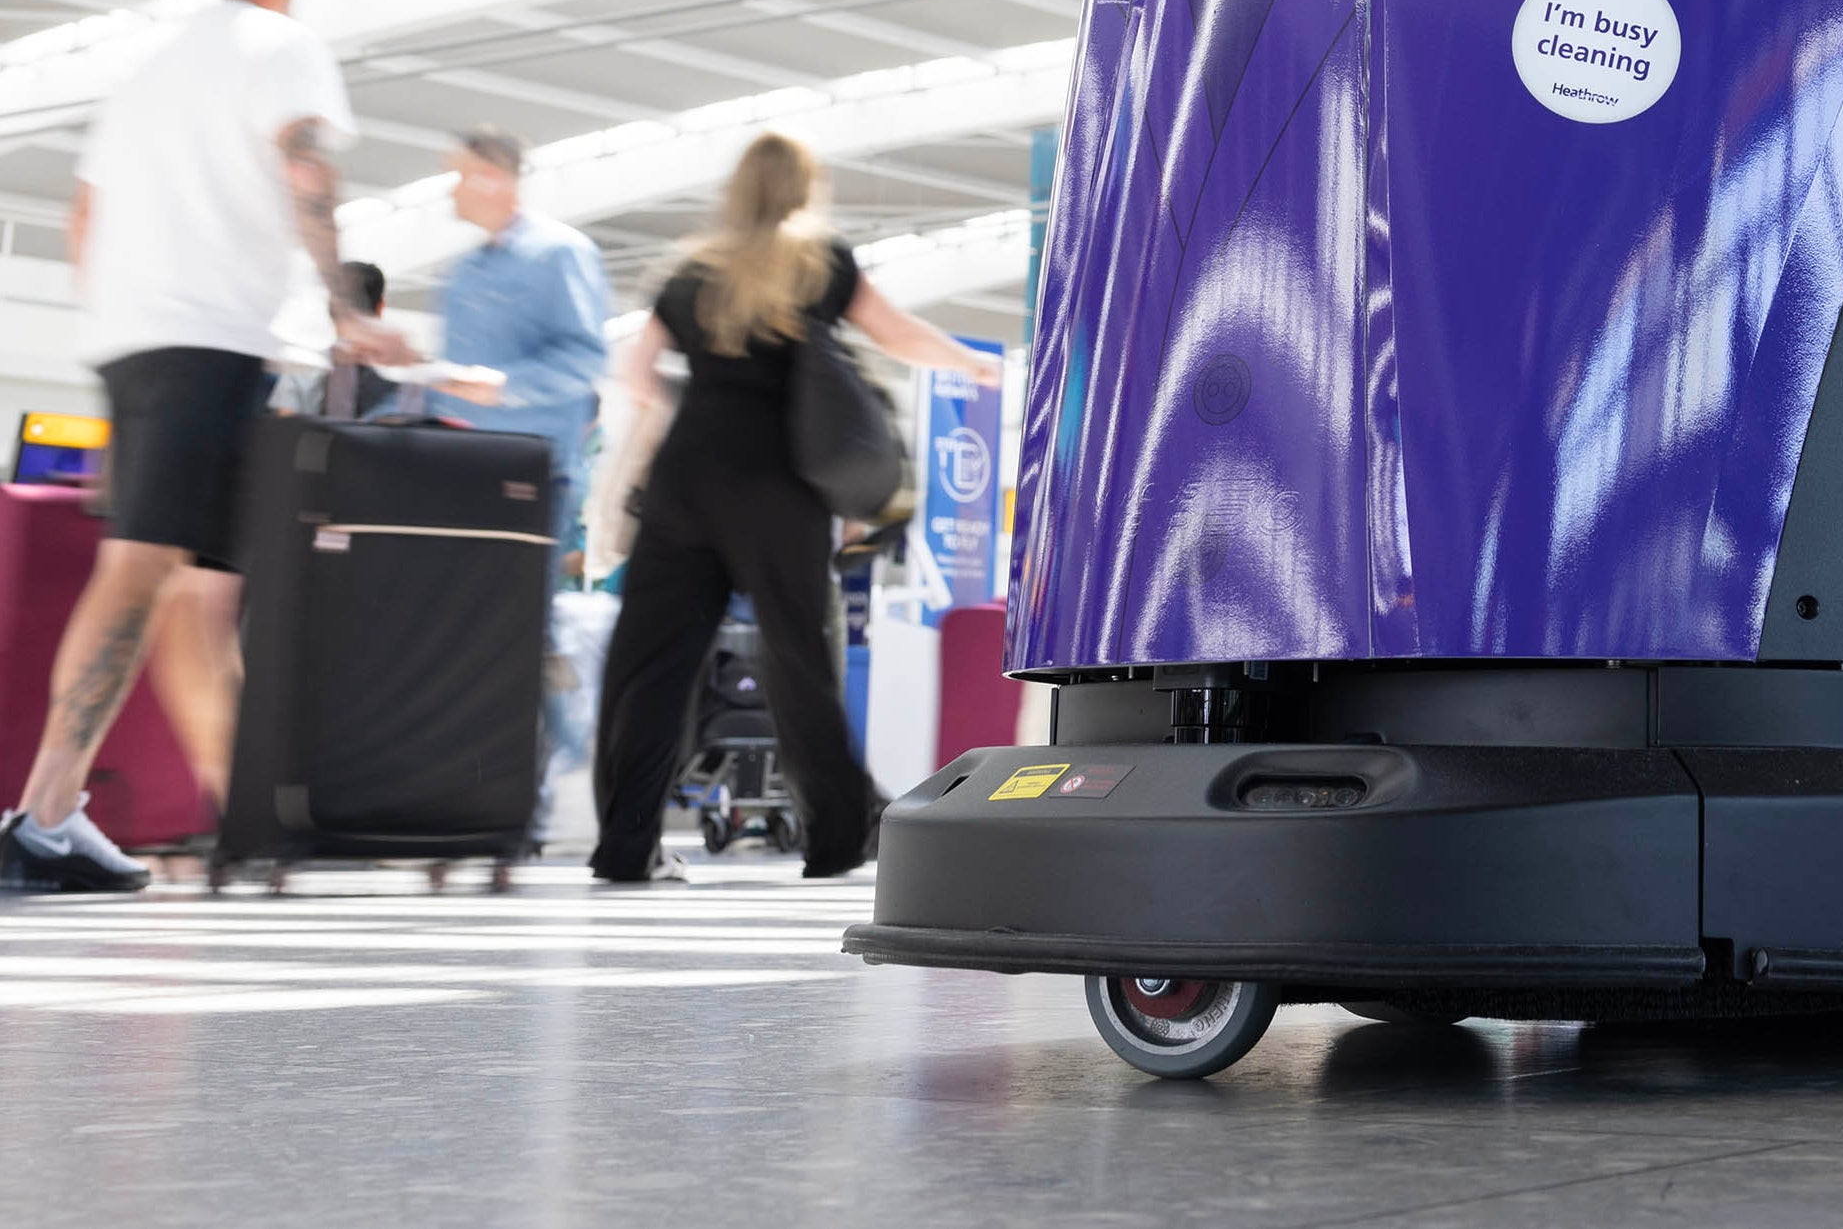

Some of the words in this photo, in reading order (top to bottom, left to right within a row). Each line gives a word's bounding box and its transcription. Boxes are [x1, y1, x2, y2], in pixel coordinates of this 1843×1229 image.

[1593, 10, 1659, 50] busy
[1536, 34, 1652, 81] cleaning
[1551, 82, 1620, 107] Heathrow
